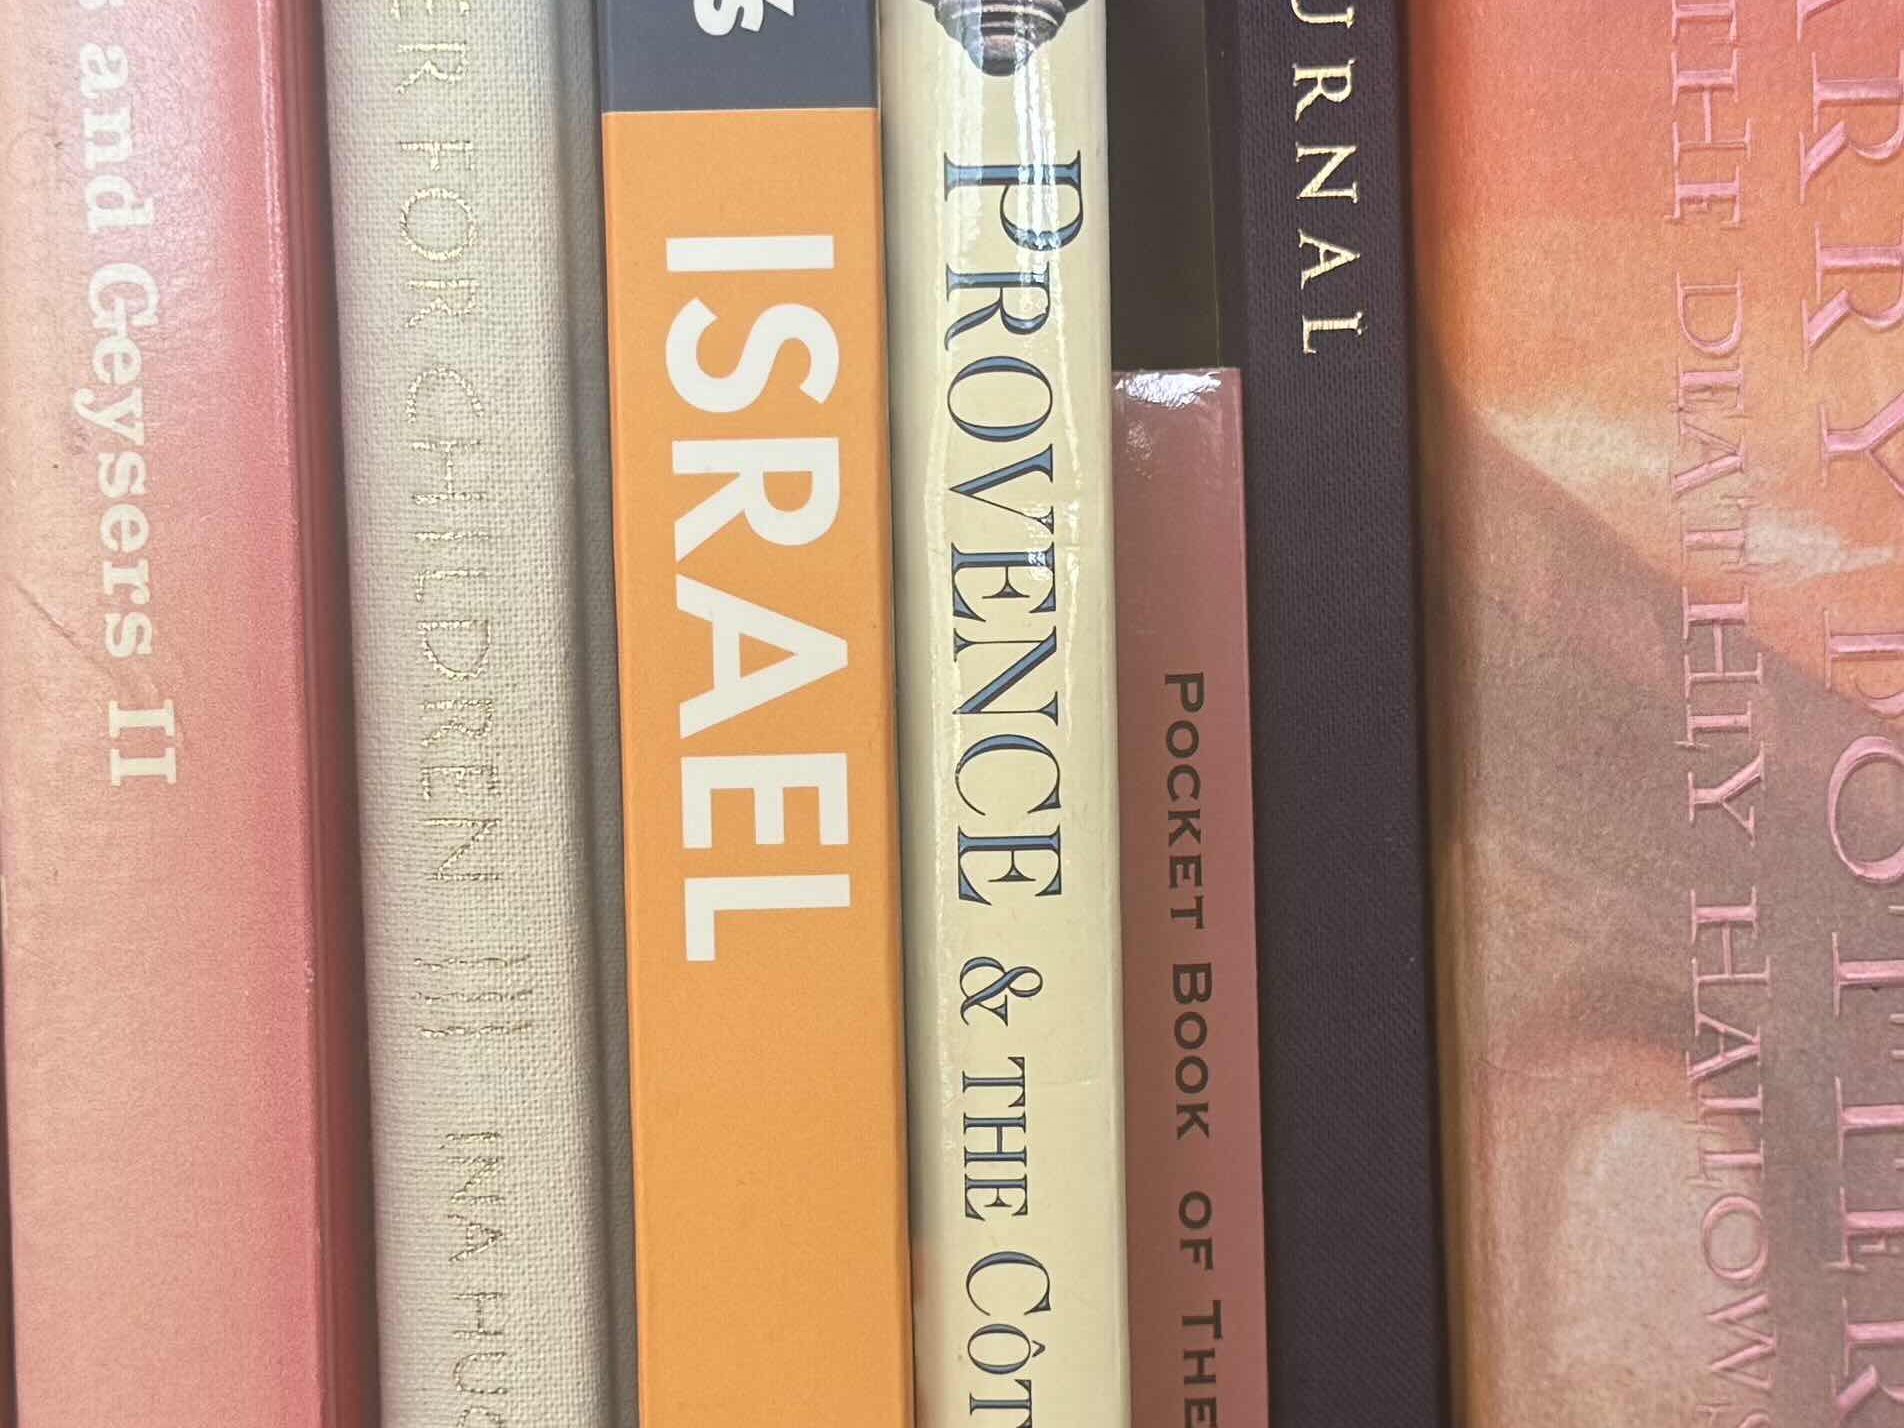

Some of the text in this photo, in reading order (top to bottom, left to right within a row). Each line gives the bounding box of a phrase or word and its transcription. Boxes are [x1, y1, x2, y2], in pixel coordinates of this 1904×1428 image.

[74, 47, 156, 240] and
[396, 137, 483, 330] FOR
[74, 262, 166, 662] Geysers
[943, 150, 1086, 907] PROVENCE
[406, 370, 502, 884] CHILDREN
[664, 232, 852, 962] ISRAEL
[106, 697, 179, 790] II
[1162, 672, 1208, 930] POCKET
[958, 957, 1046, 1027] &
[1173, 960, 1213, 1142] BOOK
[962, 1057, 1036, 1222] THE
[1178, 1190, 1218, 1267] OF
